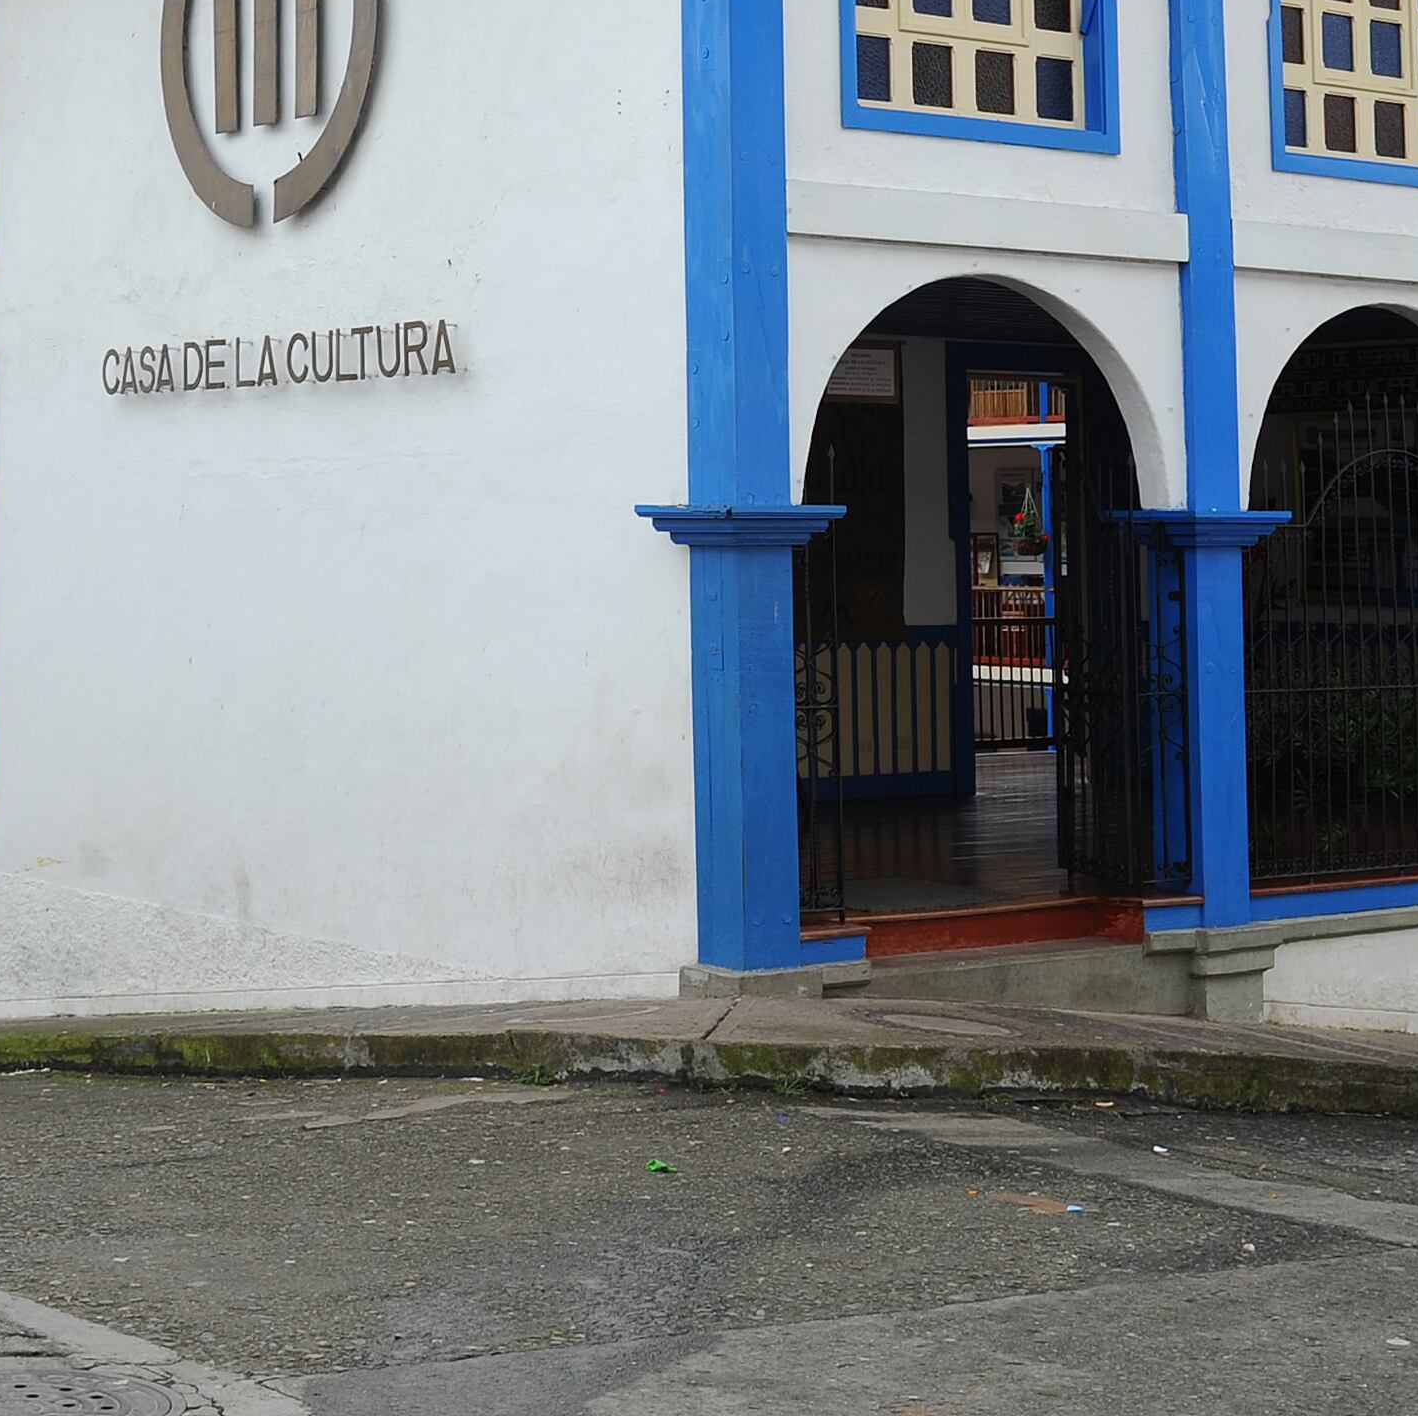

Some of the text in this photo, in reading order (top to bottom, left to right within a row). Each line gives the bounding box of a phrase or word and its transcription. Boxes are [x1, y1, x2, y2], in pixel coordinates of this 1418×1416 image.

[102, 319, 457, 395] CASA DE LA CULTURA
